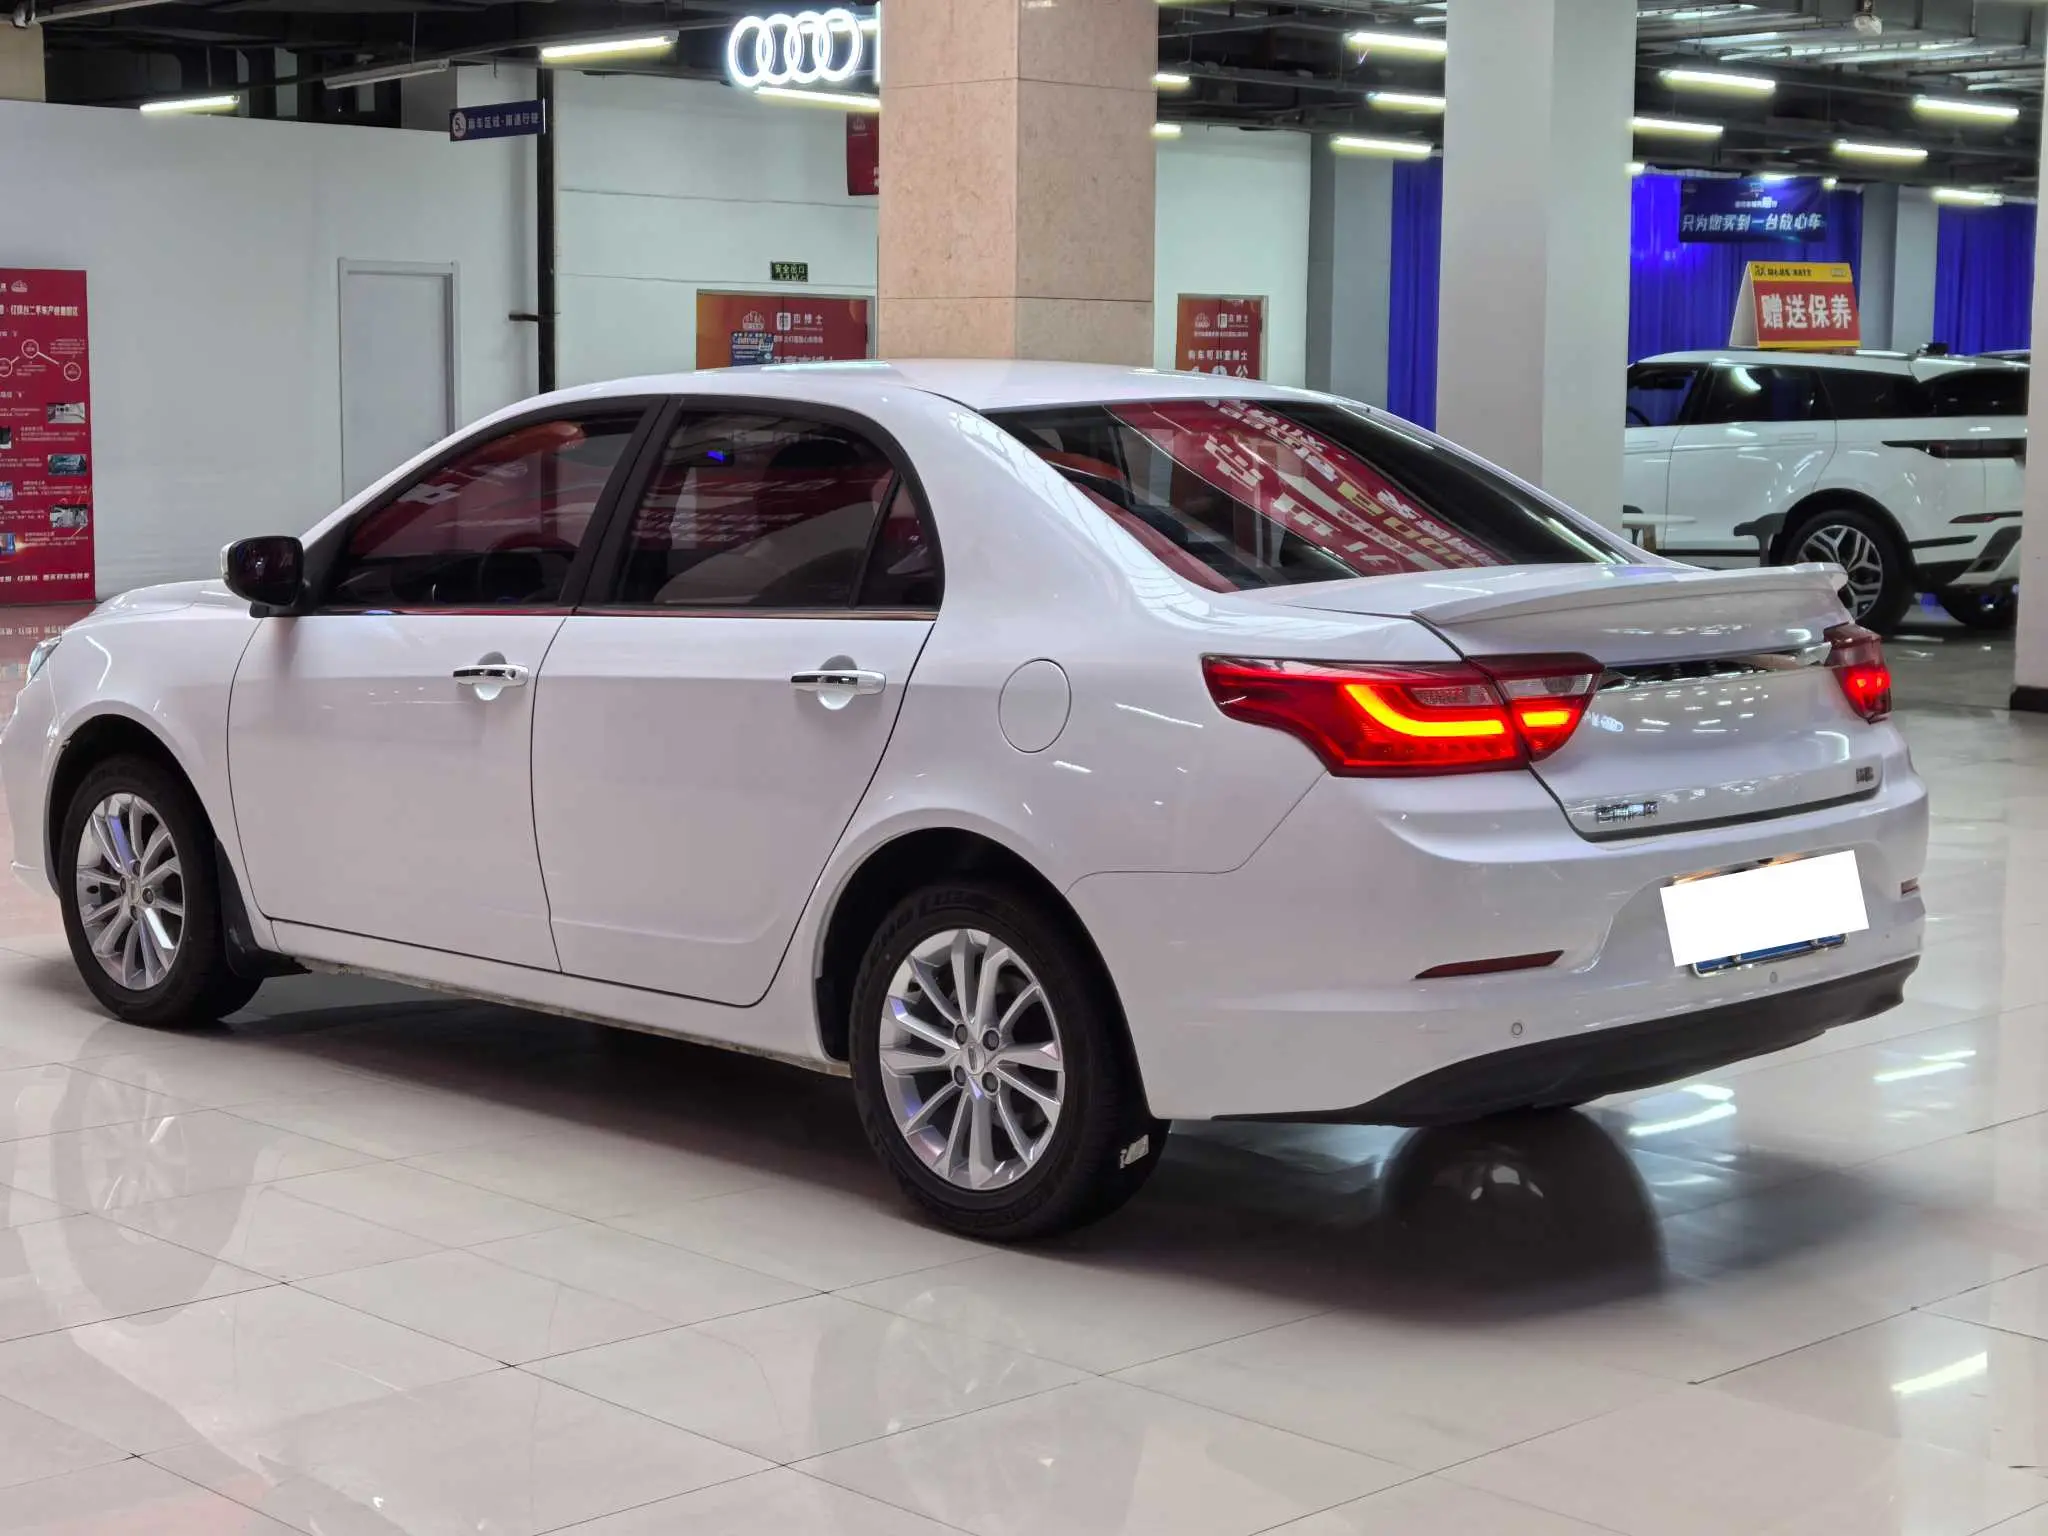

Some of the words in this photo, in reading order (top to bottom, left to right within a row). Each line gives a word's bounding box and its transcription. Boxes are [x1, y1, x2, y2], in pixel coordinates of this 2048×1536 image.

[1682, 214, 1823, 232] 只为您买到一台放心车
[775, 264, 805, 274] 安全出口
[1760, 293, 1852, 329] 赠送保养
